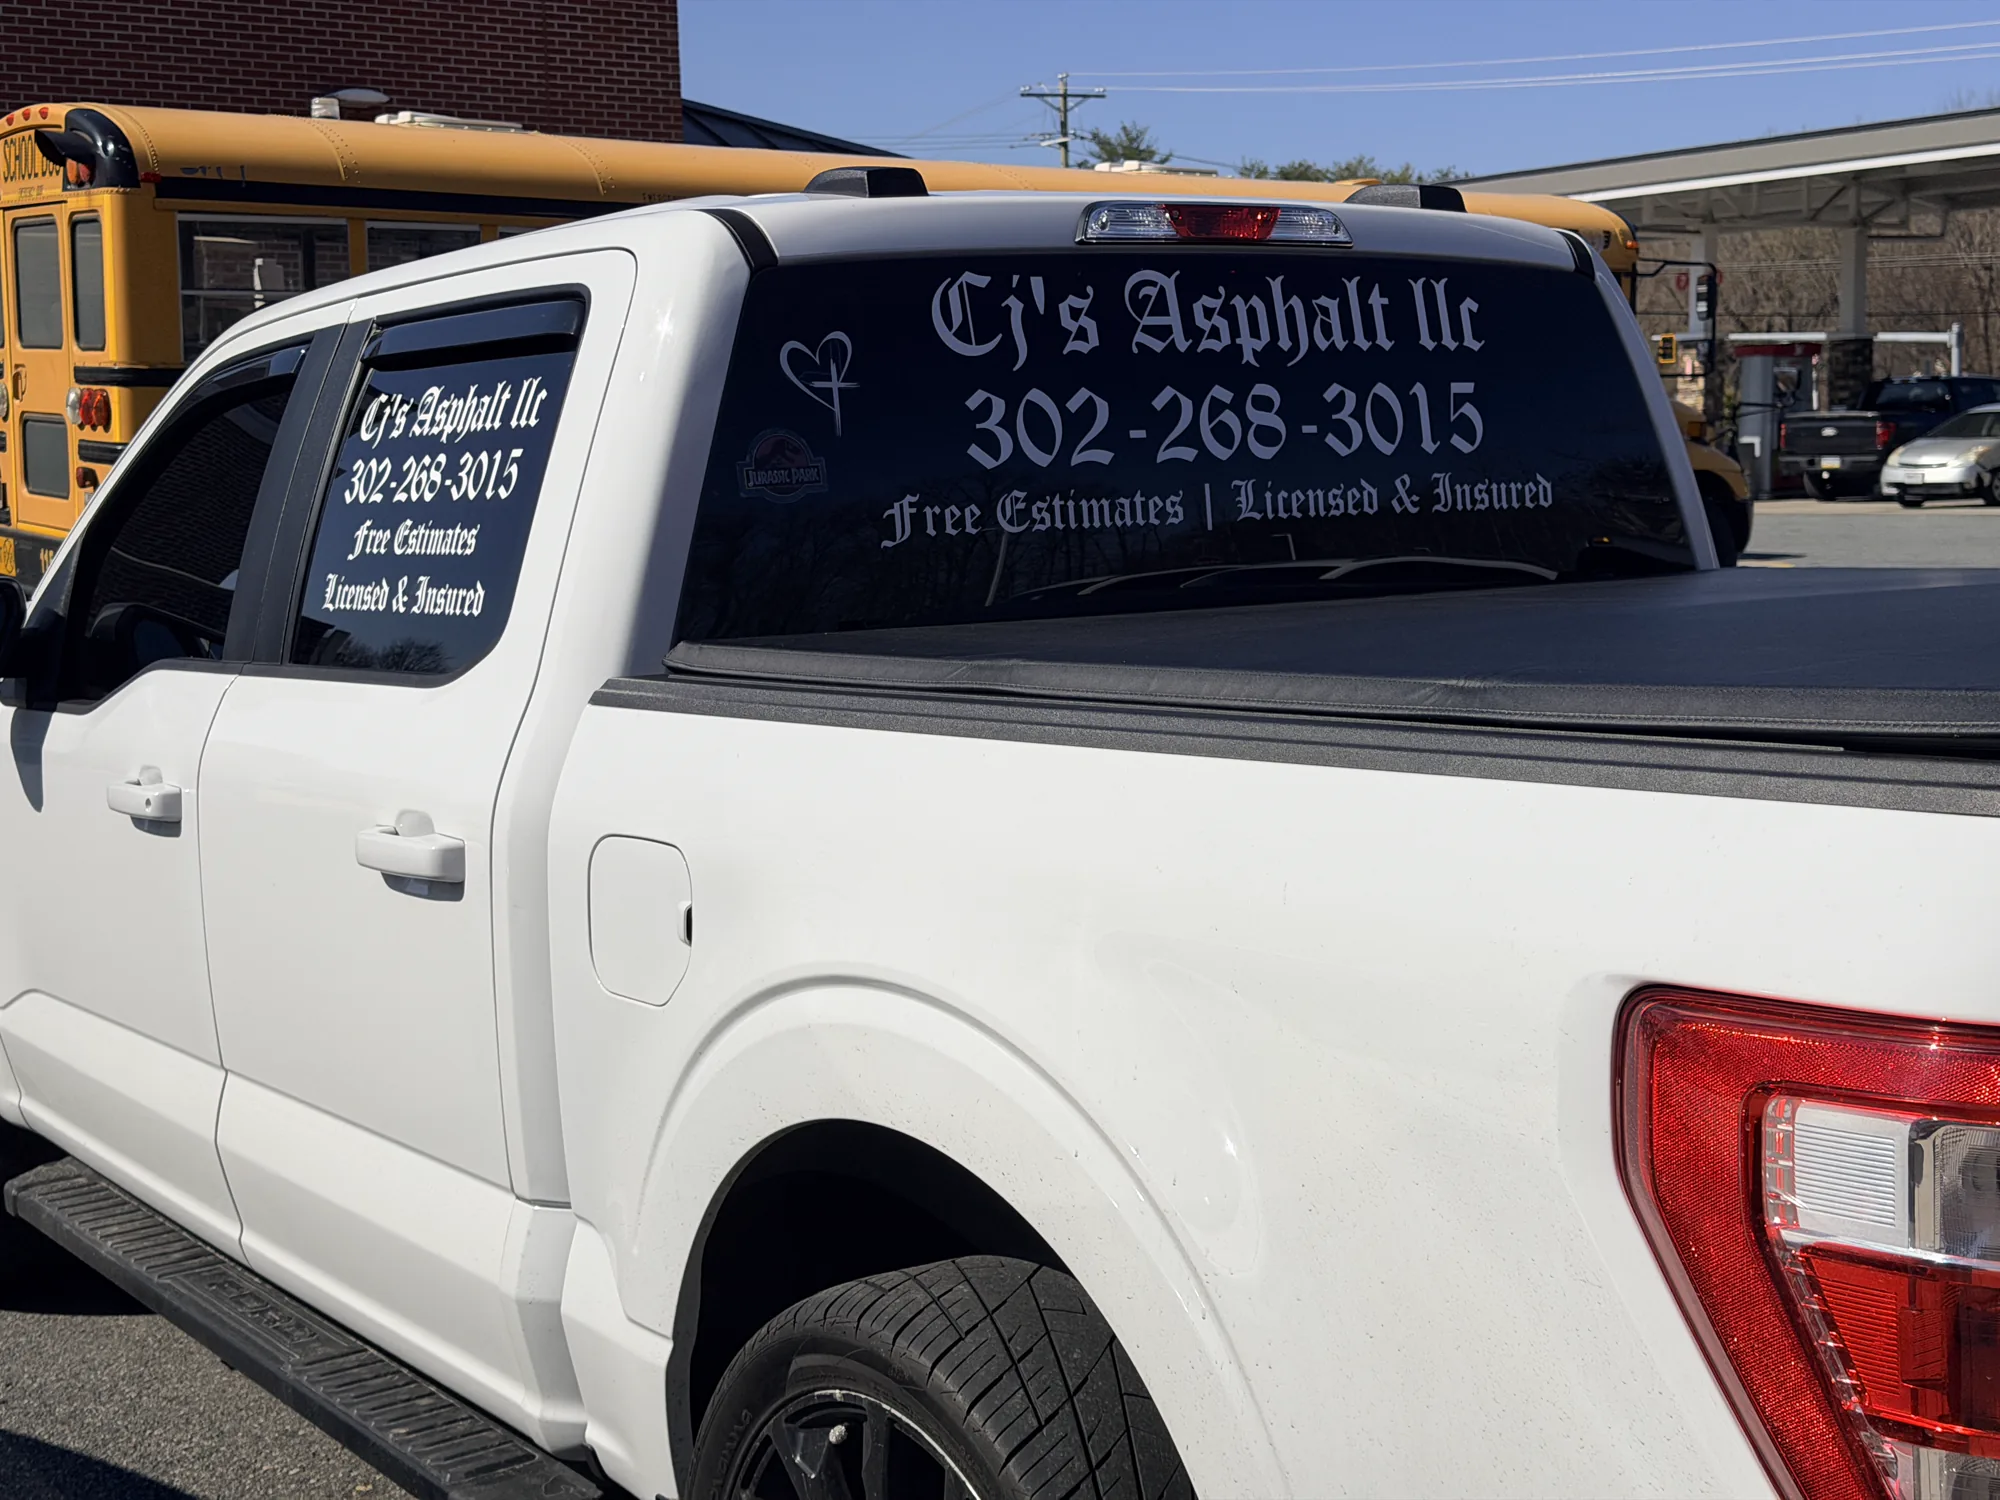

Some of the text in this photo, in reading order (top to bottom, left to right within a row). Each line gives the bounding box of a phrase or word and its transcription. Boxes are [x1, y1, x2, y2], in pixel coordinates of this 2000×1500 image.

[3, 134, 39, 183] SCHOOL
[931, 269, 1486, 372] Cj's Asphalt llc
[360, 376, 548, 449] Cj's Asphalt llc
[964, 381, 1484, 470] 302-268-3015
[344, 448, 524, 504] 302-268-3015
[747, 467, 820, 488] JURASSIC PARK
[880, 493, 983, 549] Free
[996, 489, 1184, 534] Estimates
[1230, 478, 1379, 522] Licensed
[1391, 473, 1421, 515] &
[1431, 472, 1553, 514] Insured
[346, 518, 481, 561] Free Estimates
[321, 572, 485, 617] Licensed & Insured
